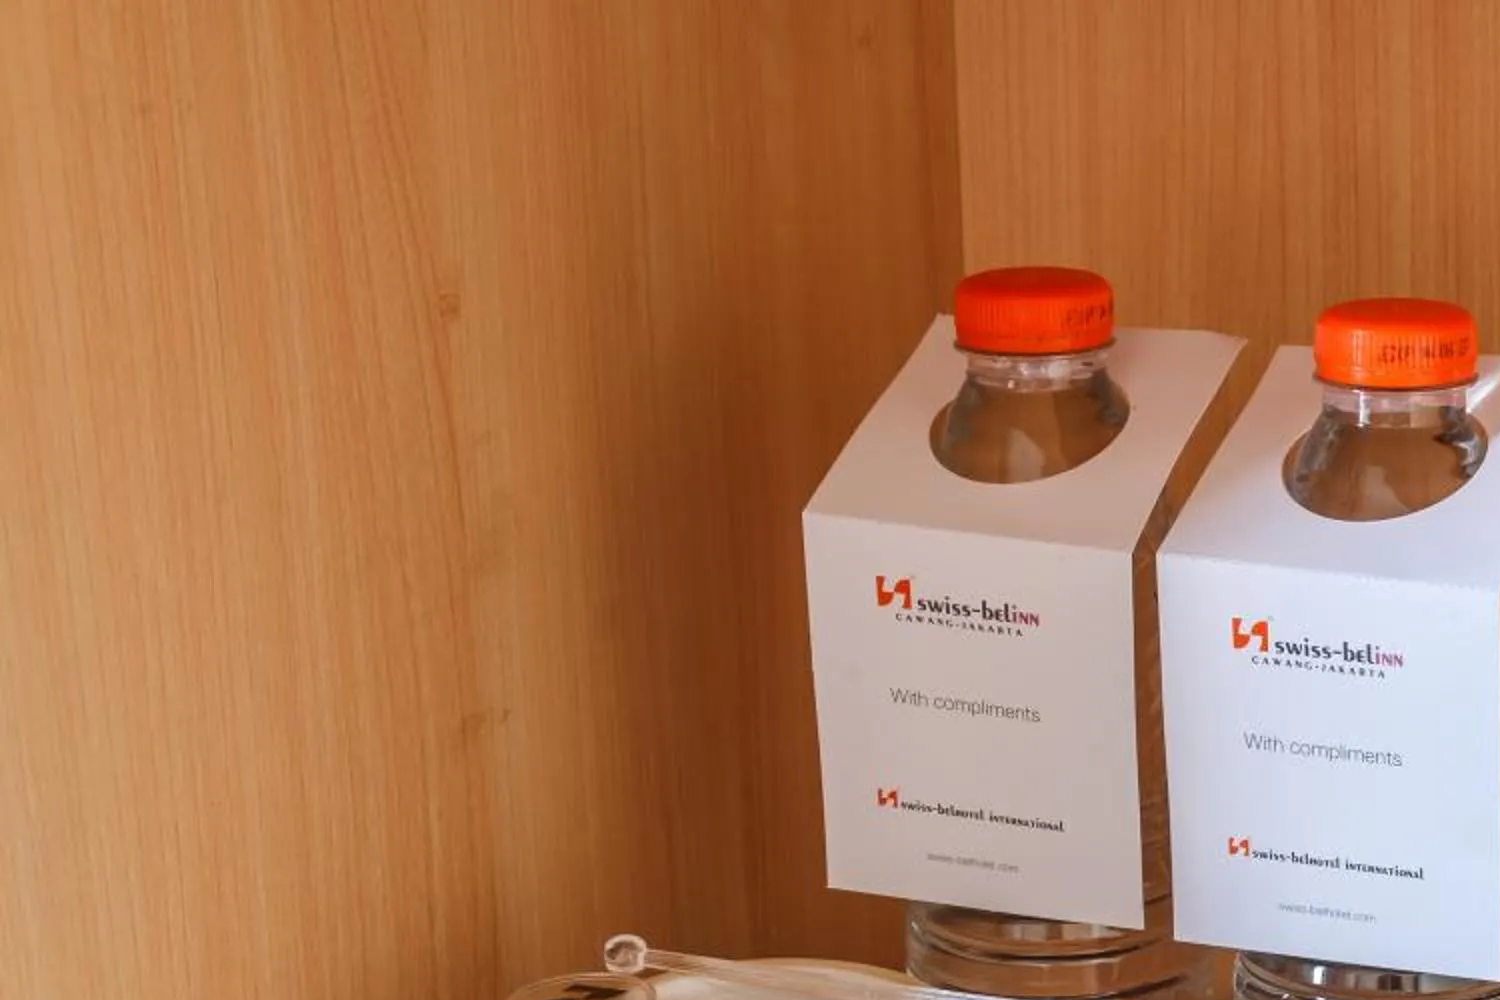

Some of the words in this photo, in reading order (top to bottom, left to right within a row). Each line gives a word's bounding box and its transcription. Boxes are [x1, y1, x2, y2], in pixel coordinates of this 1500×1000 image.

[889, 687, 929, 707] With
[933, 694, 1041, 723] compliments
[1243, 731, 1285, 753] With
[1289, 737, 1402, 768] compliments
